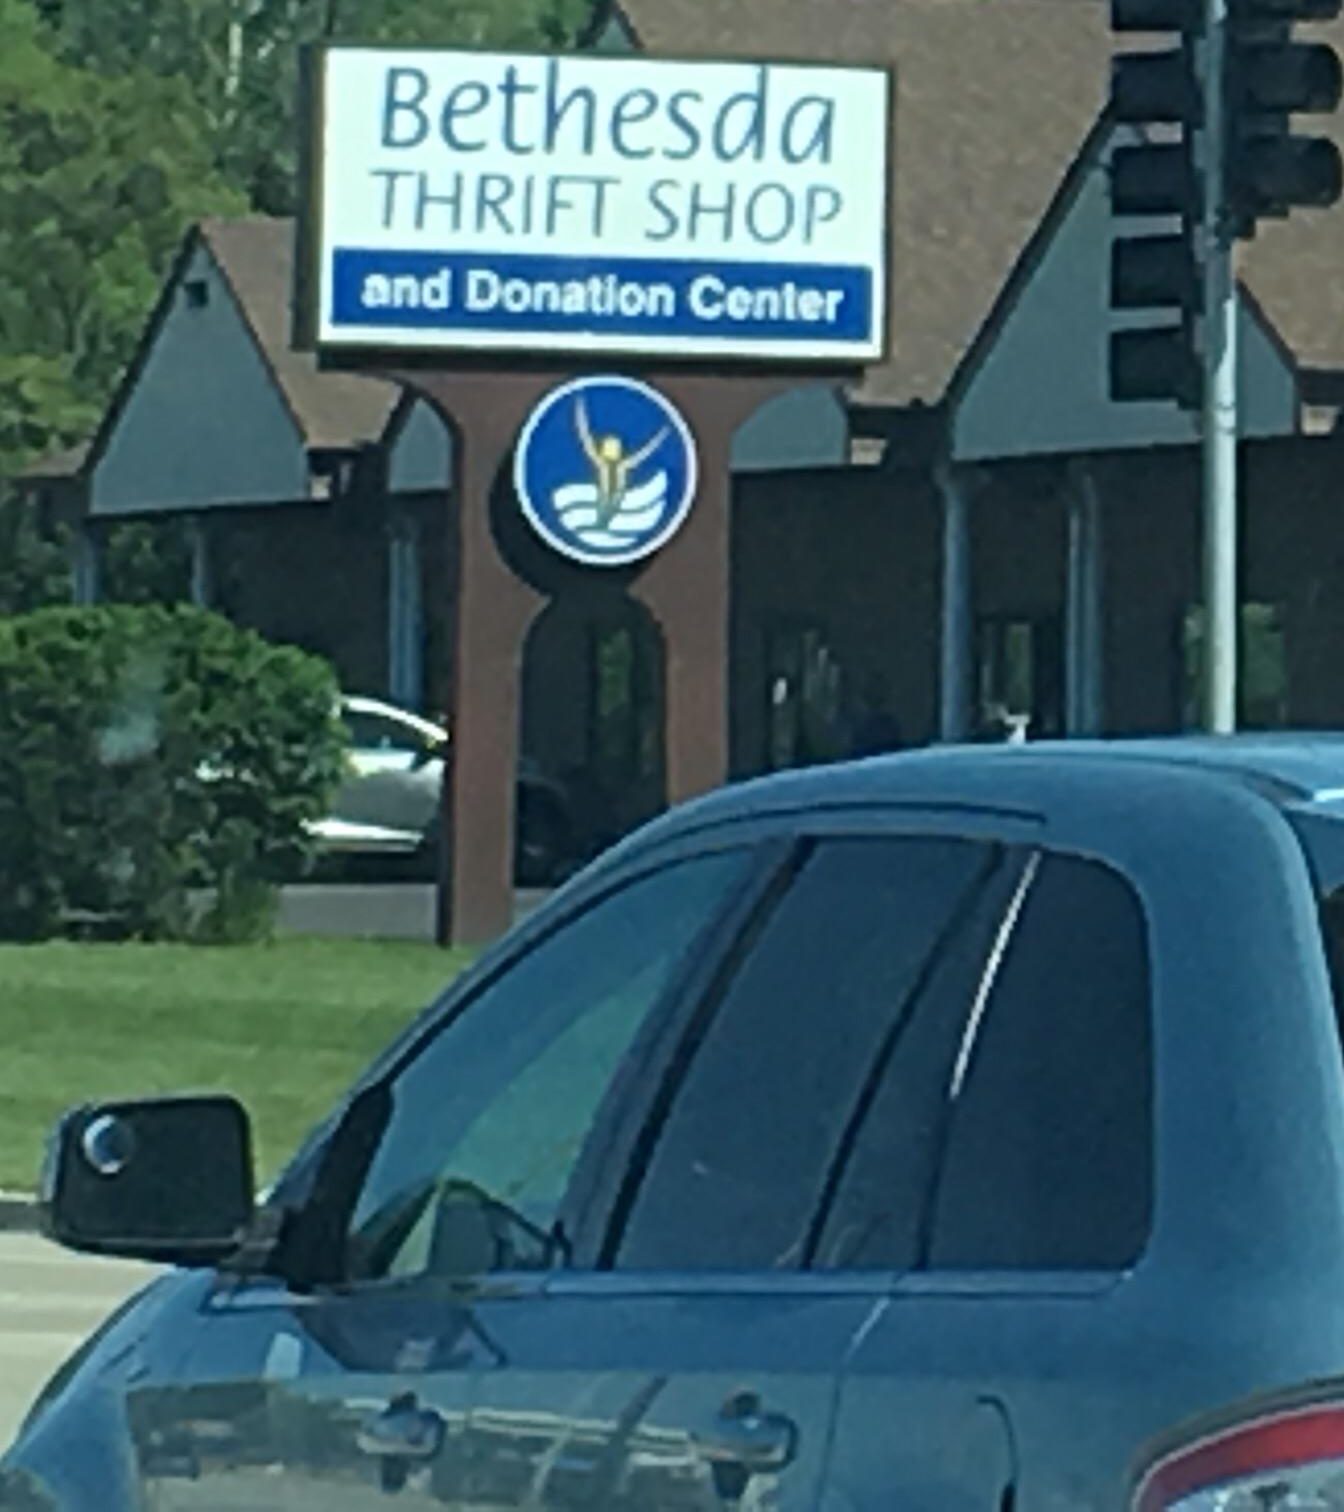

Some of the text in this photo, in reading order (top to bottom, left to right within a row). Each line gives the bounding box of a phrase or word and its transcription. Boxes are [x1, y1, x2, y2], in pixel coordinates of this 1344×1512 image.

[380, 59, 836, 164] Bethesda
[370, 169, 844, 245] THRIFT SHOP
[361, 269, 846, 322] and Donation Center
